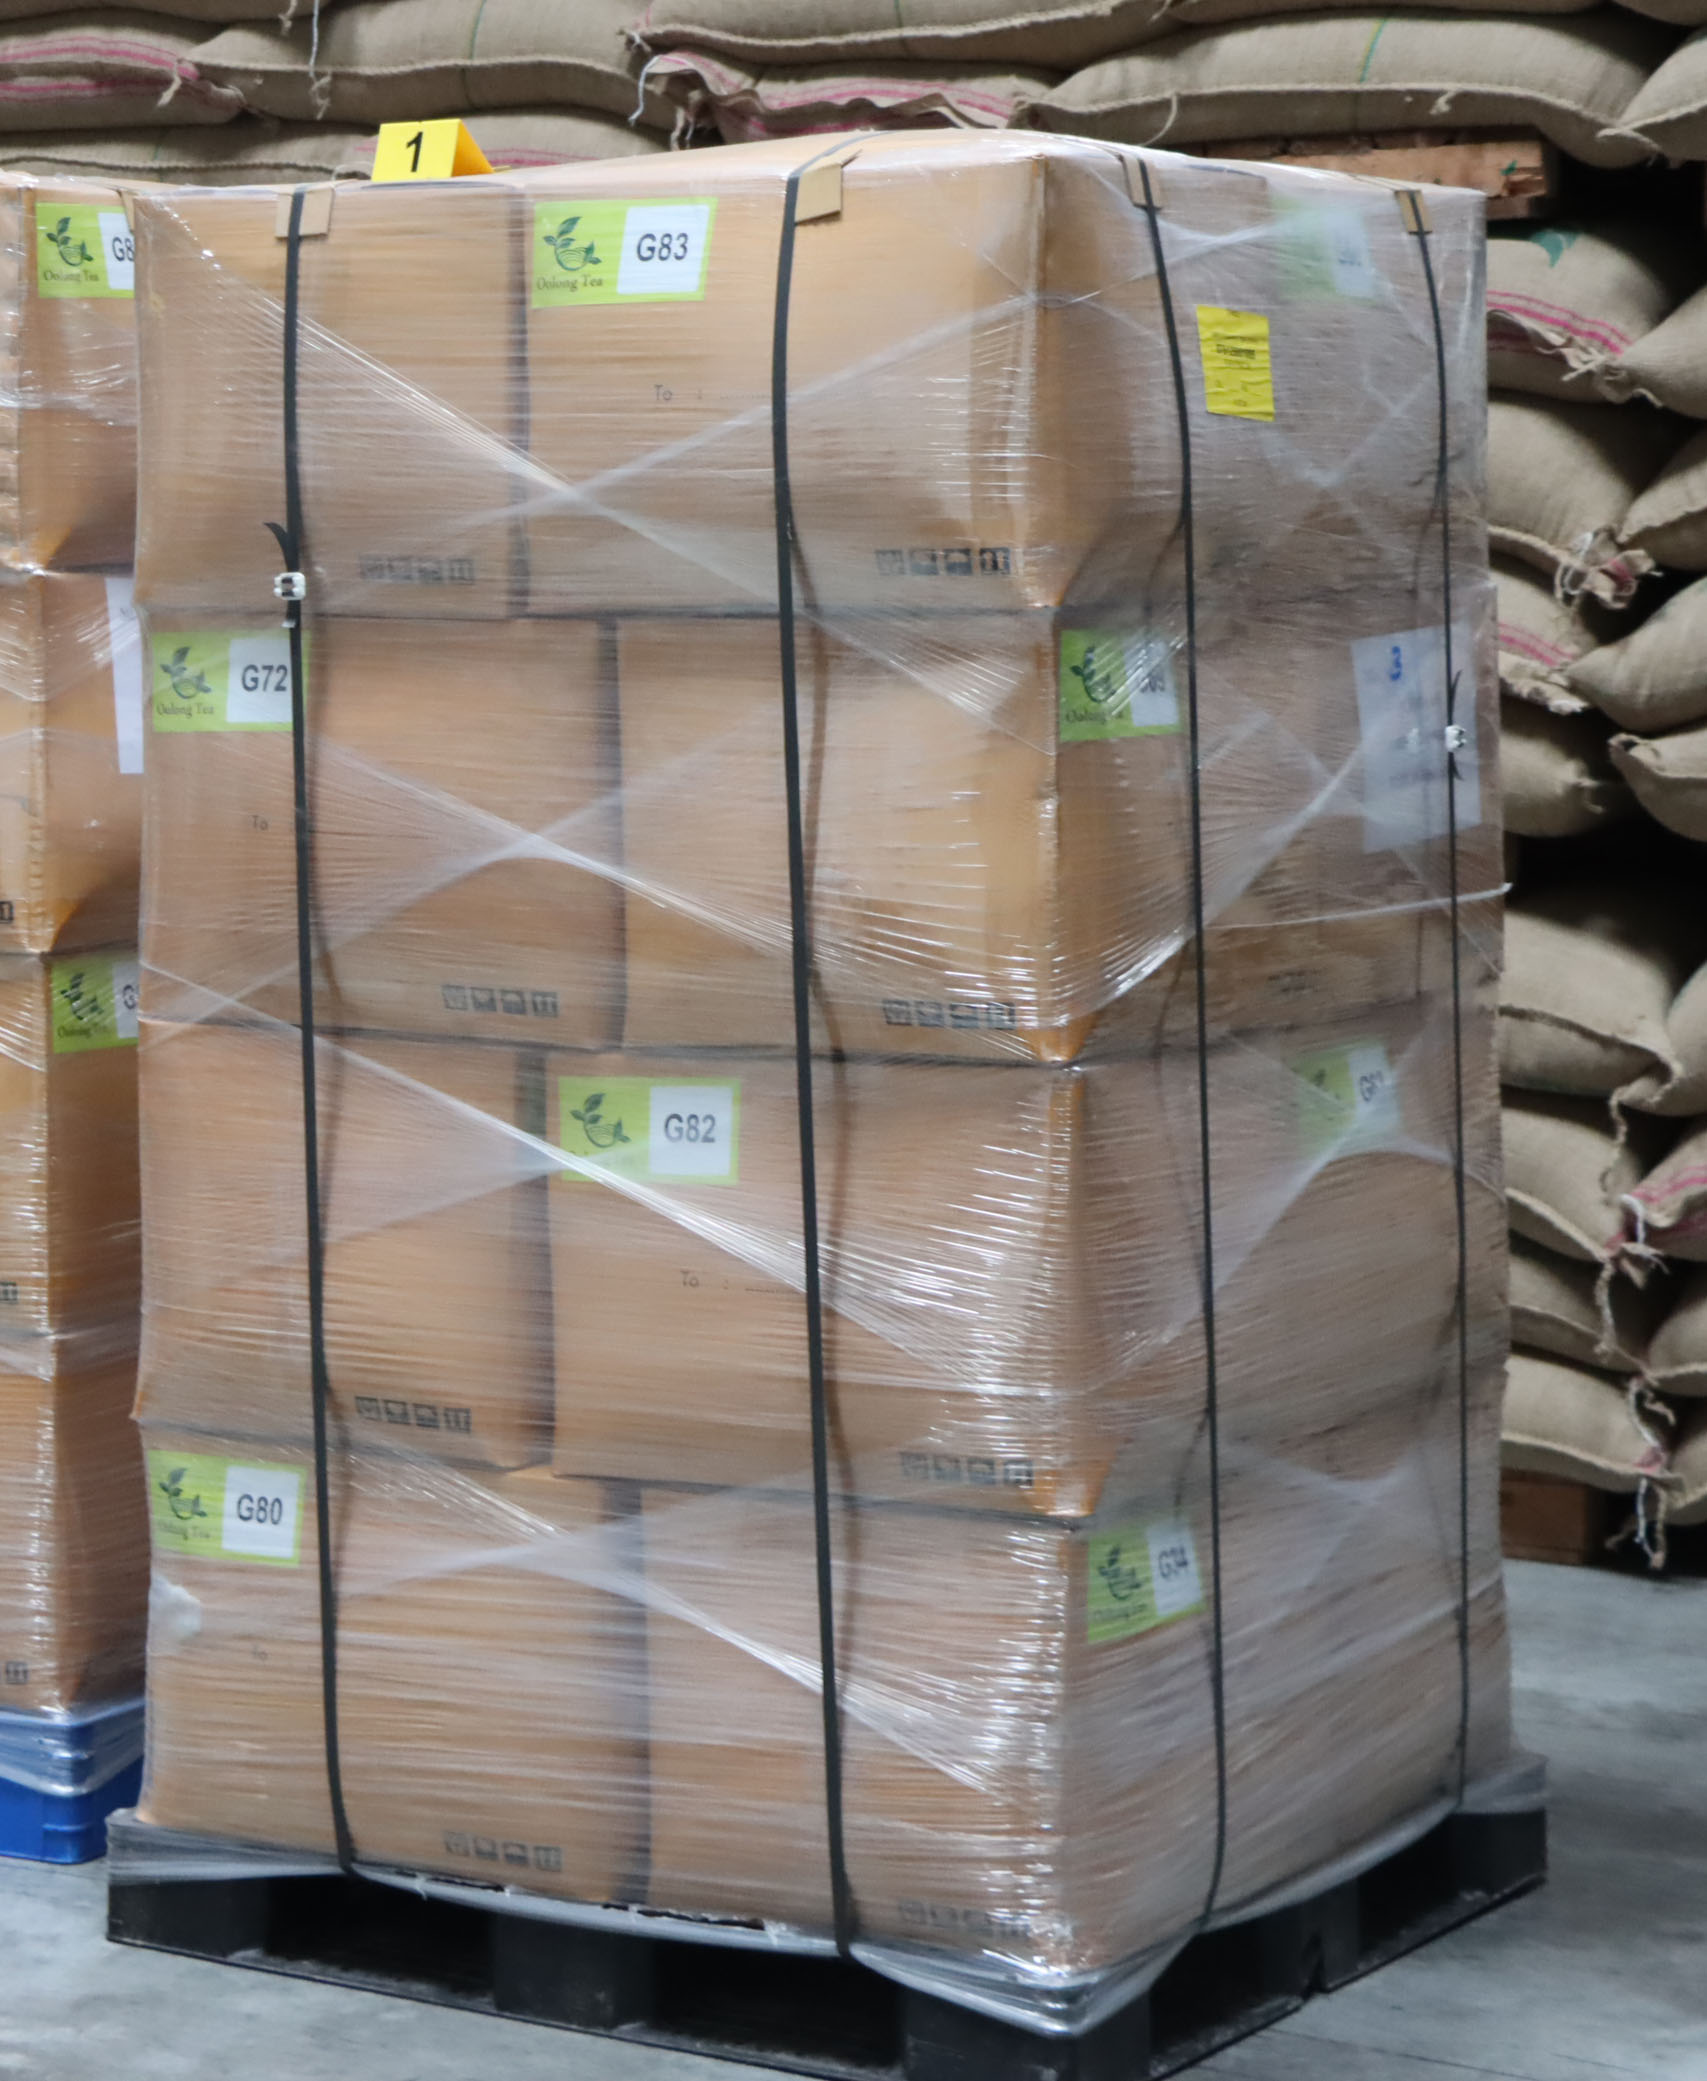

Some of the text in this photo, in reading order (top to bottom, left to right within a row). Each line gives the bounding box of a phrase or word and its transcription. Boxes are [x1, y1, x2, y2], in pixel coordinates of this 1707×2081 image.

[405, 131, 425, 173] 1
[636, 231, 690, 263] G83
[581, 274, 604, 289] Tea
[241, 663, 289, 693] G72
[664, 1112, 717, 1145] G82
[236, 1493, 284, 1526] G80
